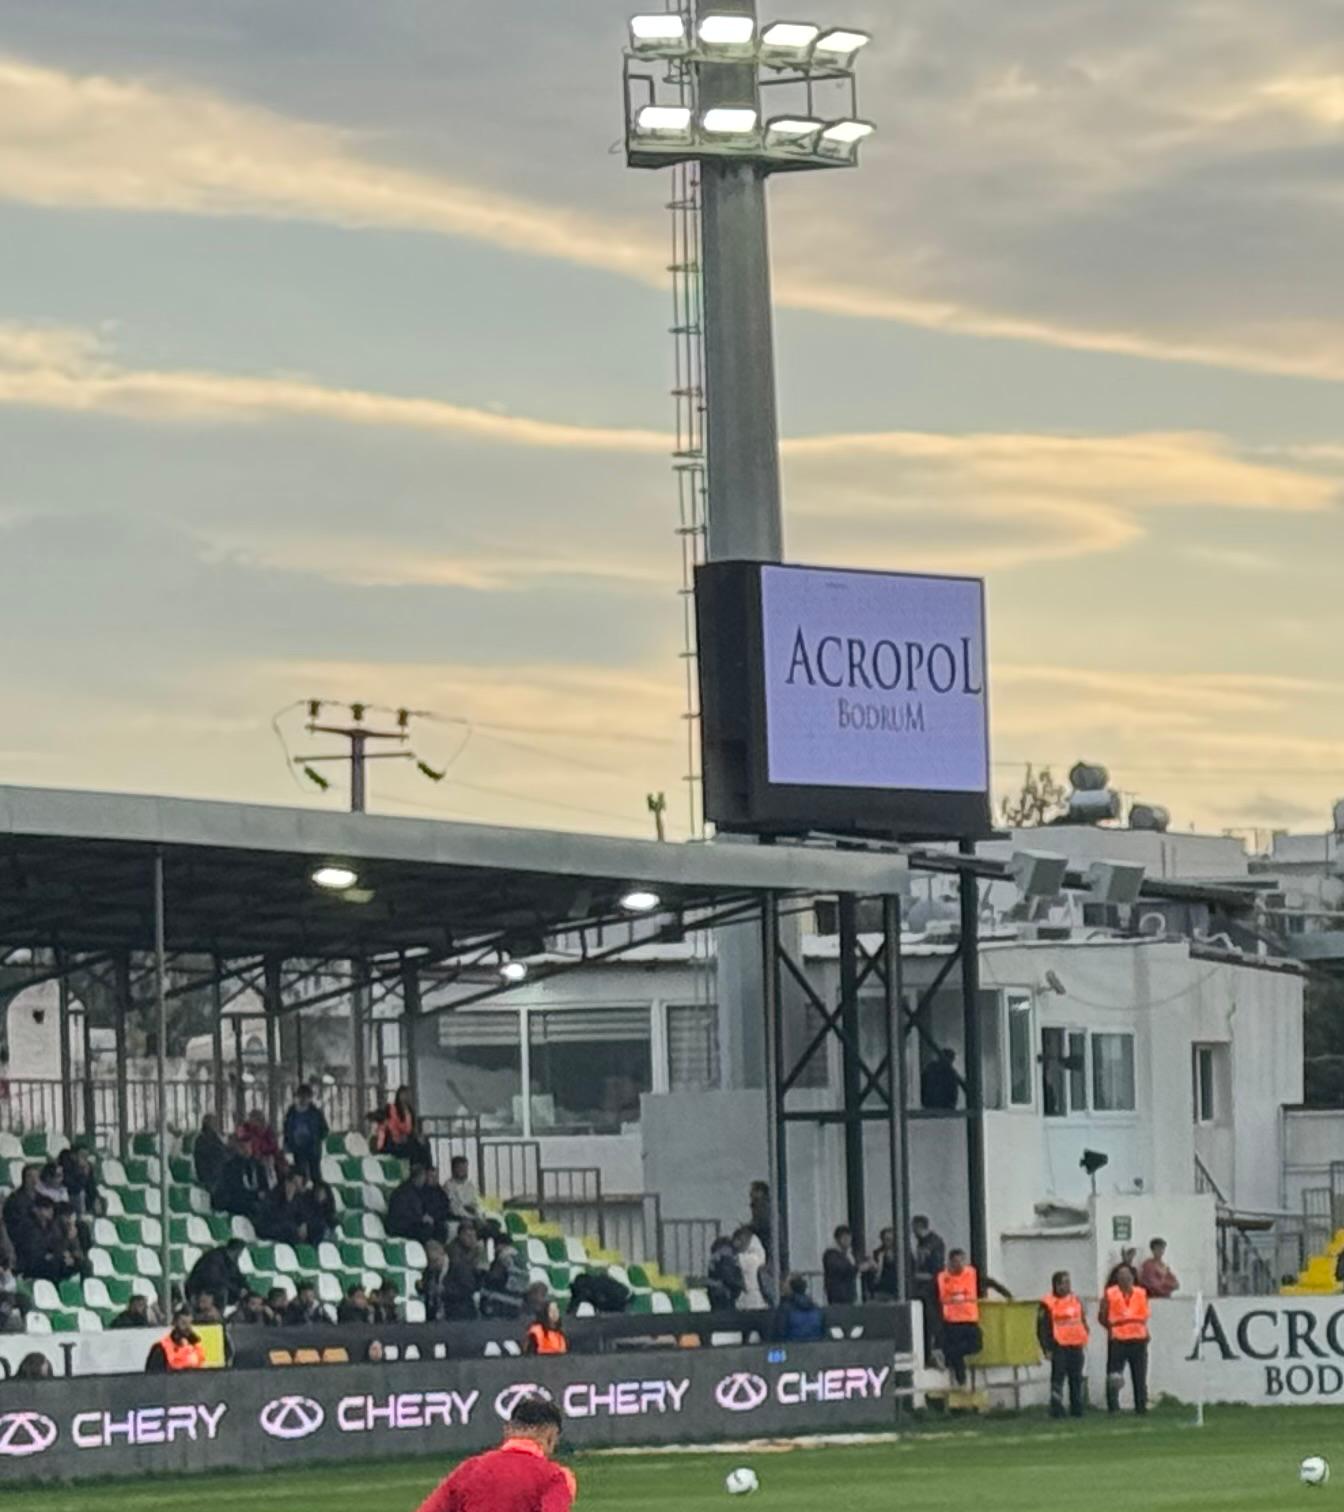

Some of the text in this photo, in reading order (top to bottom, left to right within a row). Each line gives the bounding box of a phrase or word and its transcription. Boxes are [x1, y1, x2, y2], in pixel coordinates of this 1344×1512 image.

[785, 624, 982, 695] ACROPOL
[837, 697, 925, 732] BODRUM
[563, 1378, 690, 1418] CHERY
[777, 1365, 890, 1405] CHERY
[72, 1402, 227, 1449] CHERY
[338, 1390, 480, 1432] CHERY
